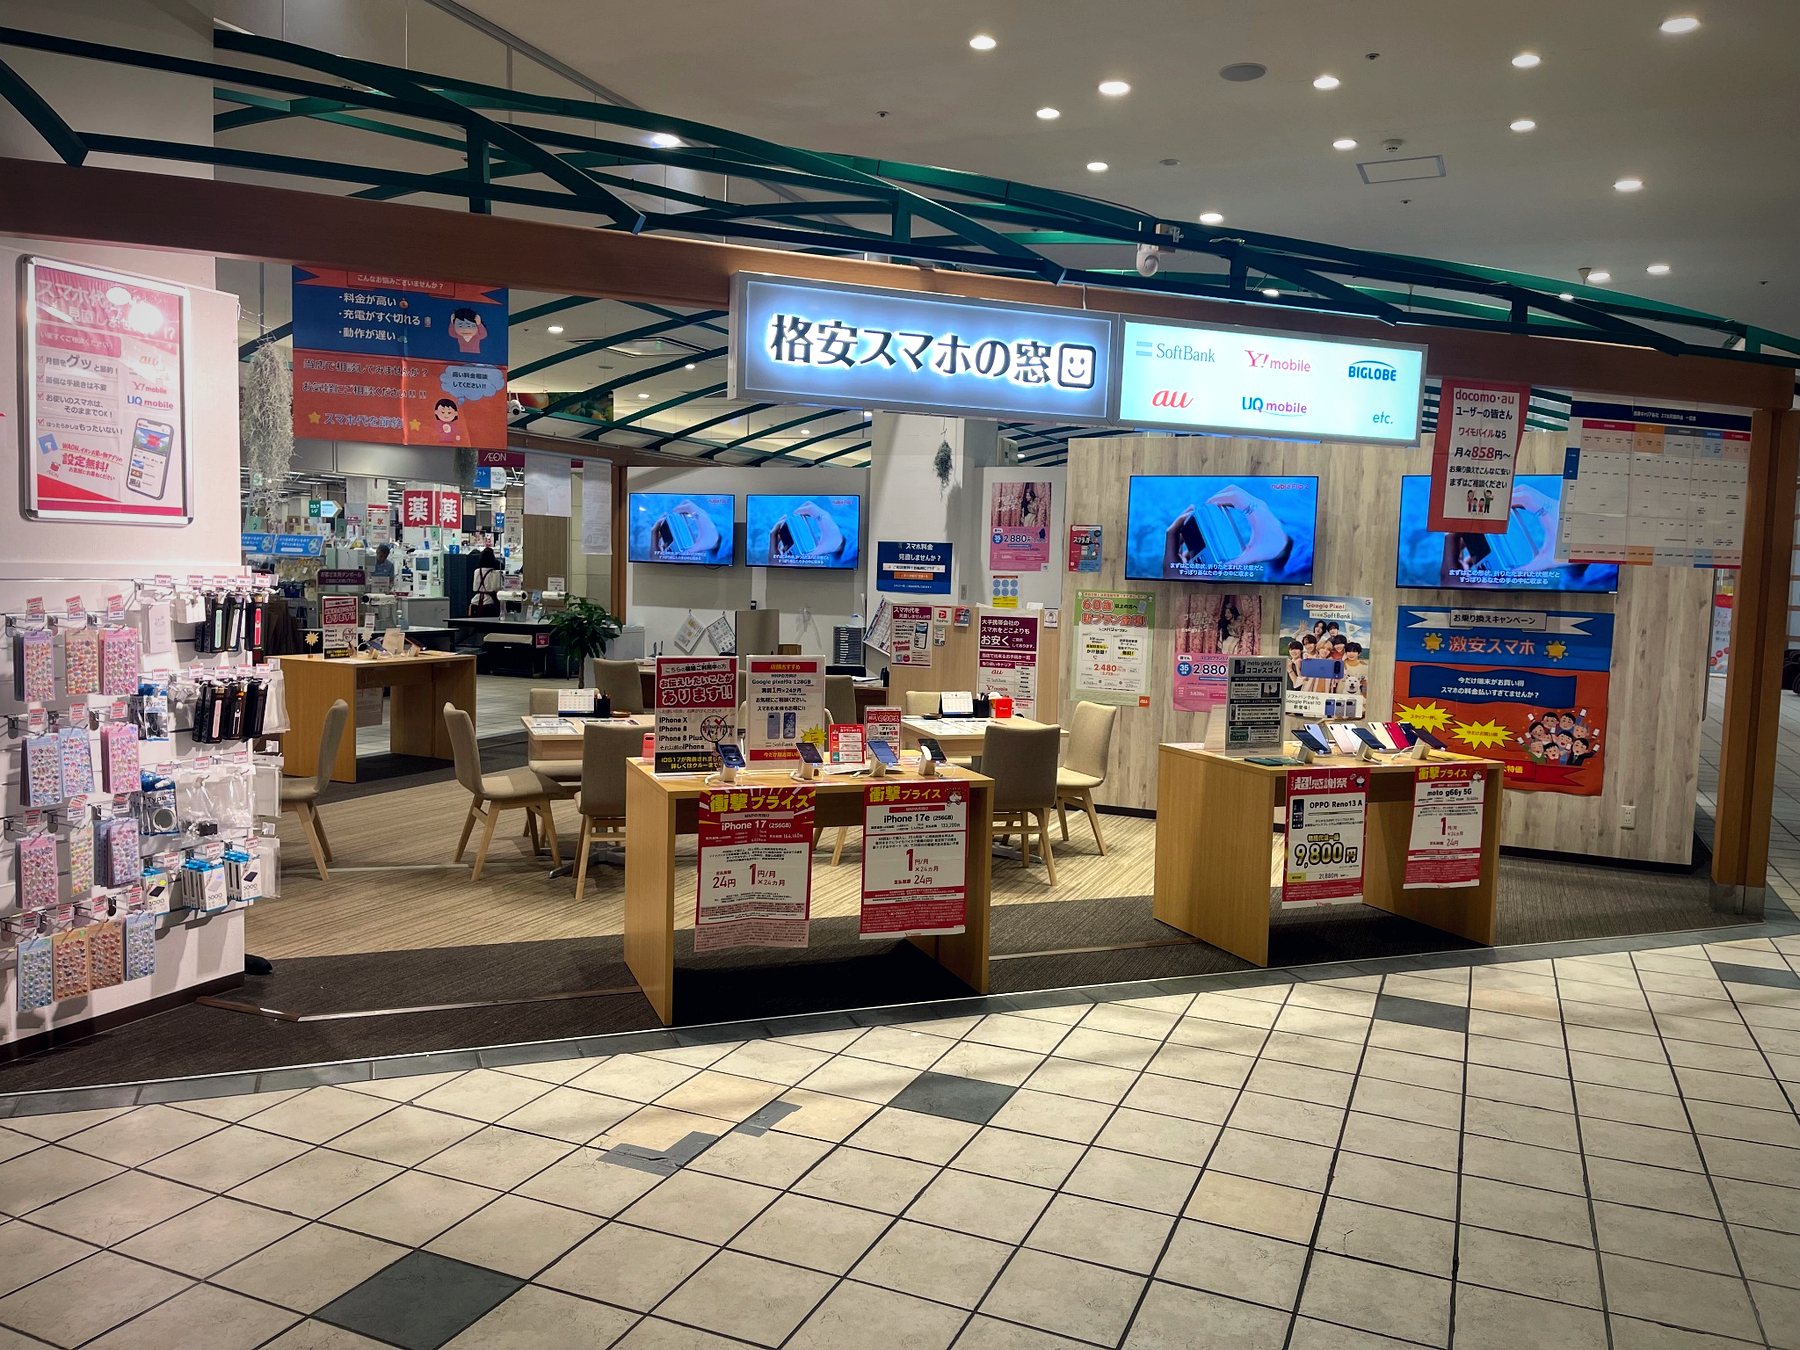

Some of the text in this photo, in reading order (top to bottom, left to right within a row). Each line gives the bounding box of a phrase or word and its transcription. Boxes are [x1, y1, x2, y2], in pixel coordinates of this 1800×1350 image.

[1156, 342, 1215, 362] SoftBank
[1348, 365, 1396, 381] BIGLOBE
[144, 399, 174, 409] mobile
[1152, 389, 1194, 409] au
[1242, 396, 1307, 414] UQ mobile
[1373, 411, 1394, 425] etc.
[1455, 406, 1513, 420] ユーザーの皆さん
[1458, 427, 1507, 439] ワイモバイルなら
[1449, 478, 1508, 489] まずはご相談ください
[408, 496, 428, 521] 薬
[440, 497, 457, 522] 薬
[1305, 602, 1328, 610] Google
[1453, 613, 1536, 625] お乗り換えキャンペーン
[980, 635, 1009, 646] お安く
[1448, 636, 1535, 655] 激安スマホ
[660, 674, 734, 689] お伝えしたいことが
[1458, 677, 1525, 687] 今だけ端末がお買い得
[1441, 686, 1540, 698] スマホの料金払いすぎてませんか？
[1418, 766, 1468, 780] 衝撃プライス
[869, 785, 942, 802] 衝撃プライス
[710, 793, 810, 812] 衝撃プライス
[1309, 801, 1329, 809] OPPO
[884, 813, 912, 823] iPhone
[915, 813, 930, 822] 17e
[721, 822, 752, 831] iPhone
[755, 820, 767, 829] 17
[906, 849, 914, 871] 1
[712, 876, 737, 889] 24円
[914, 875, 932, 885] 24円
